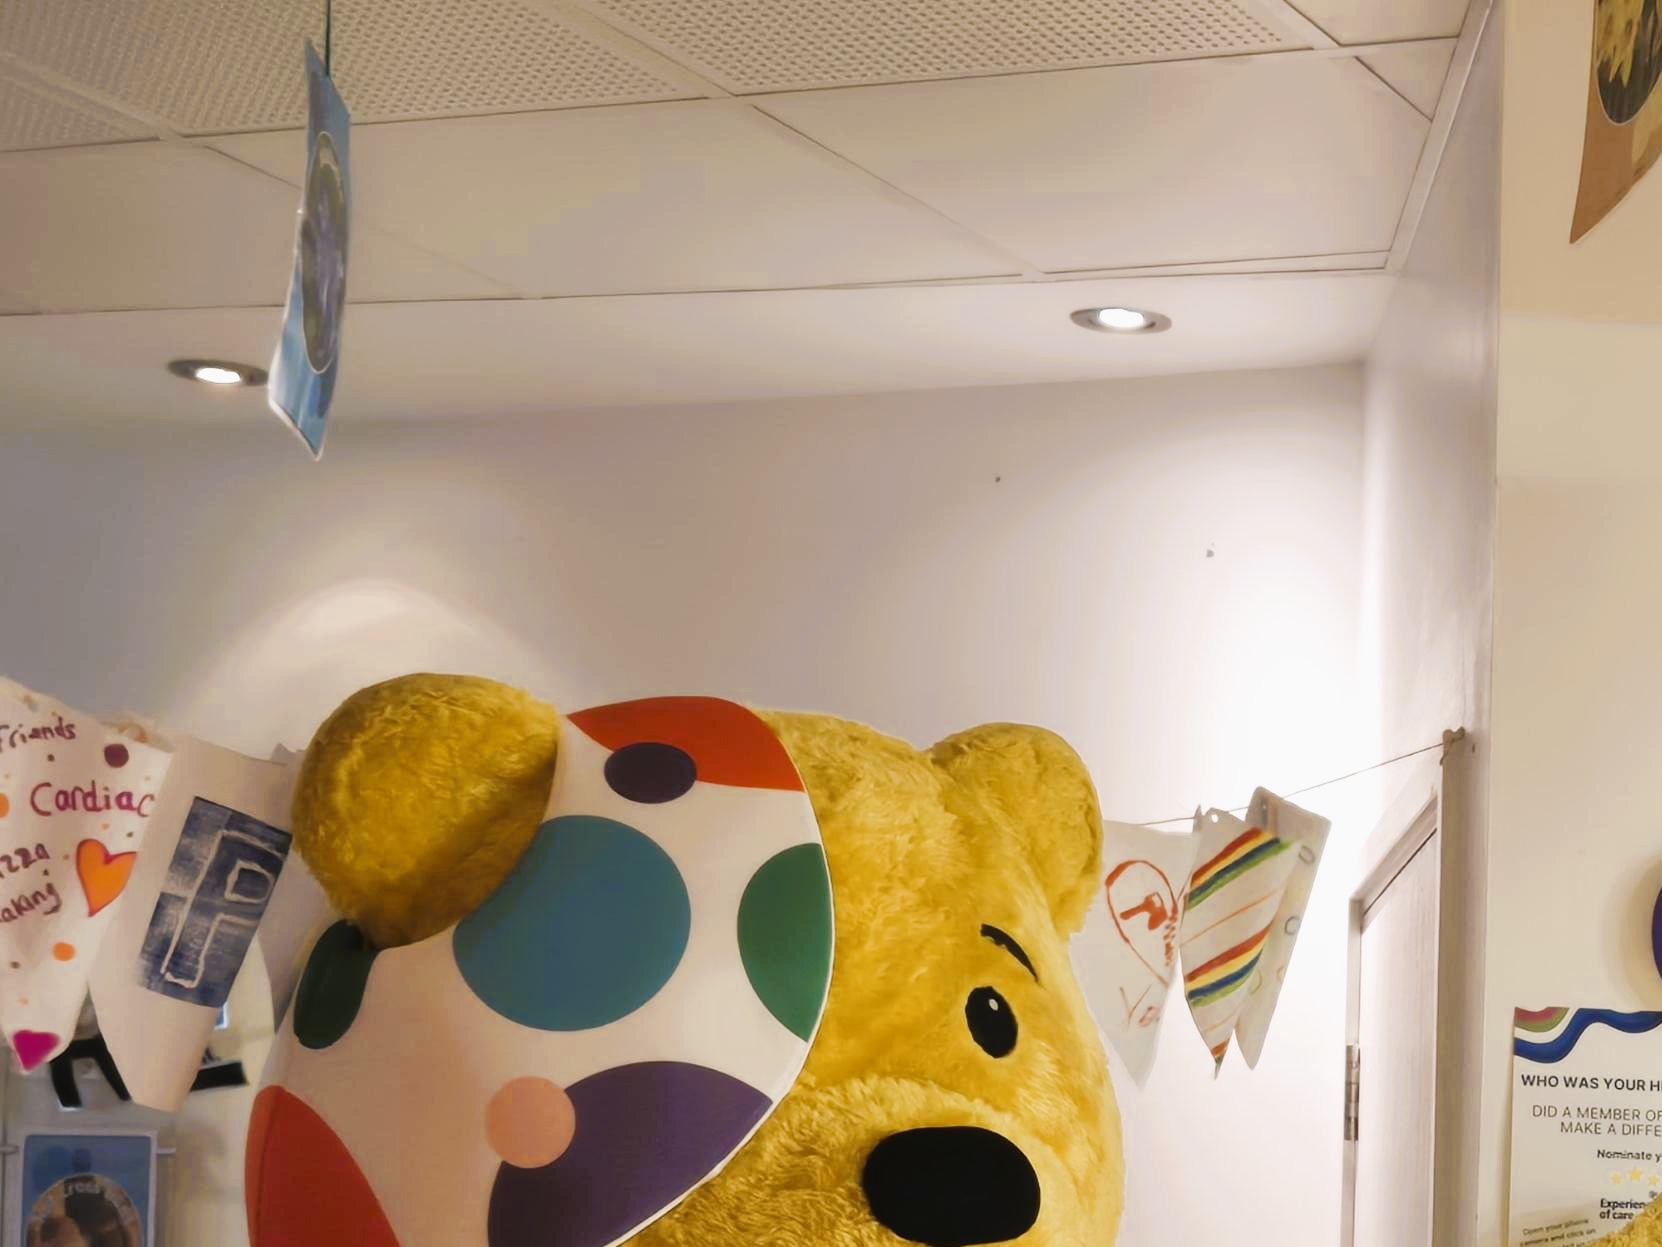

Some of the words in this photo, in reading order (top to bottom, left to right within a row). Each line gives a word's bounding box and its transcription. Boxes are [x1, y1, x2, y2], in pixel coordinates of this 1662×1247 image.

[30, 780, 155, 817] Cardiac
[1521, 1074, 1559, 1088] WHO
[1563, 1075, 1599, 1090] WAS
[1604, 1077, 1646, 1092] YOUR
[1531, 1104, 1558, 1118] DID
[1562, 1106, 1572, 1119] A
[1576, 1106, 1641, 1121] MEMBER
[1560, 1121, 1602, 1135] MAKE
[1607, 1123, 1617, 1136] A
[1596, 1149, 1652, 1161] Nominate
[1599, 1197, 1648, 1209] Experien
[1599, 1209, 1610, 1220] of
[1612, 1211, 1634, 1220] care
